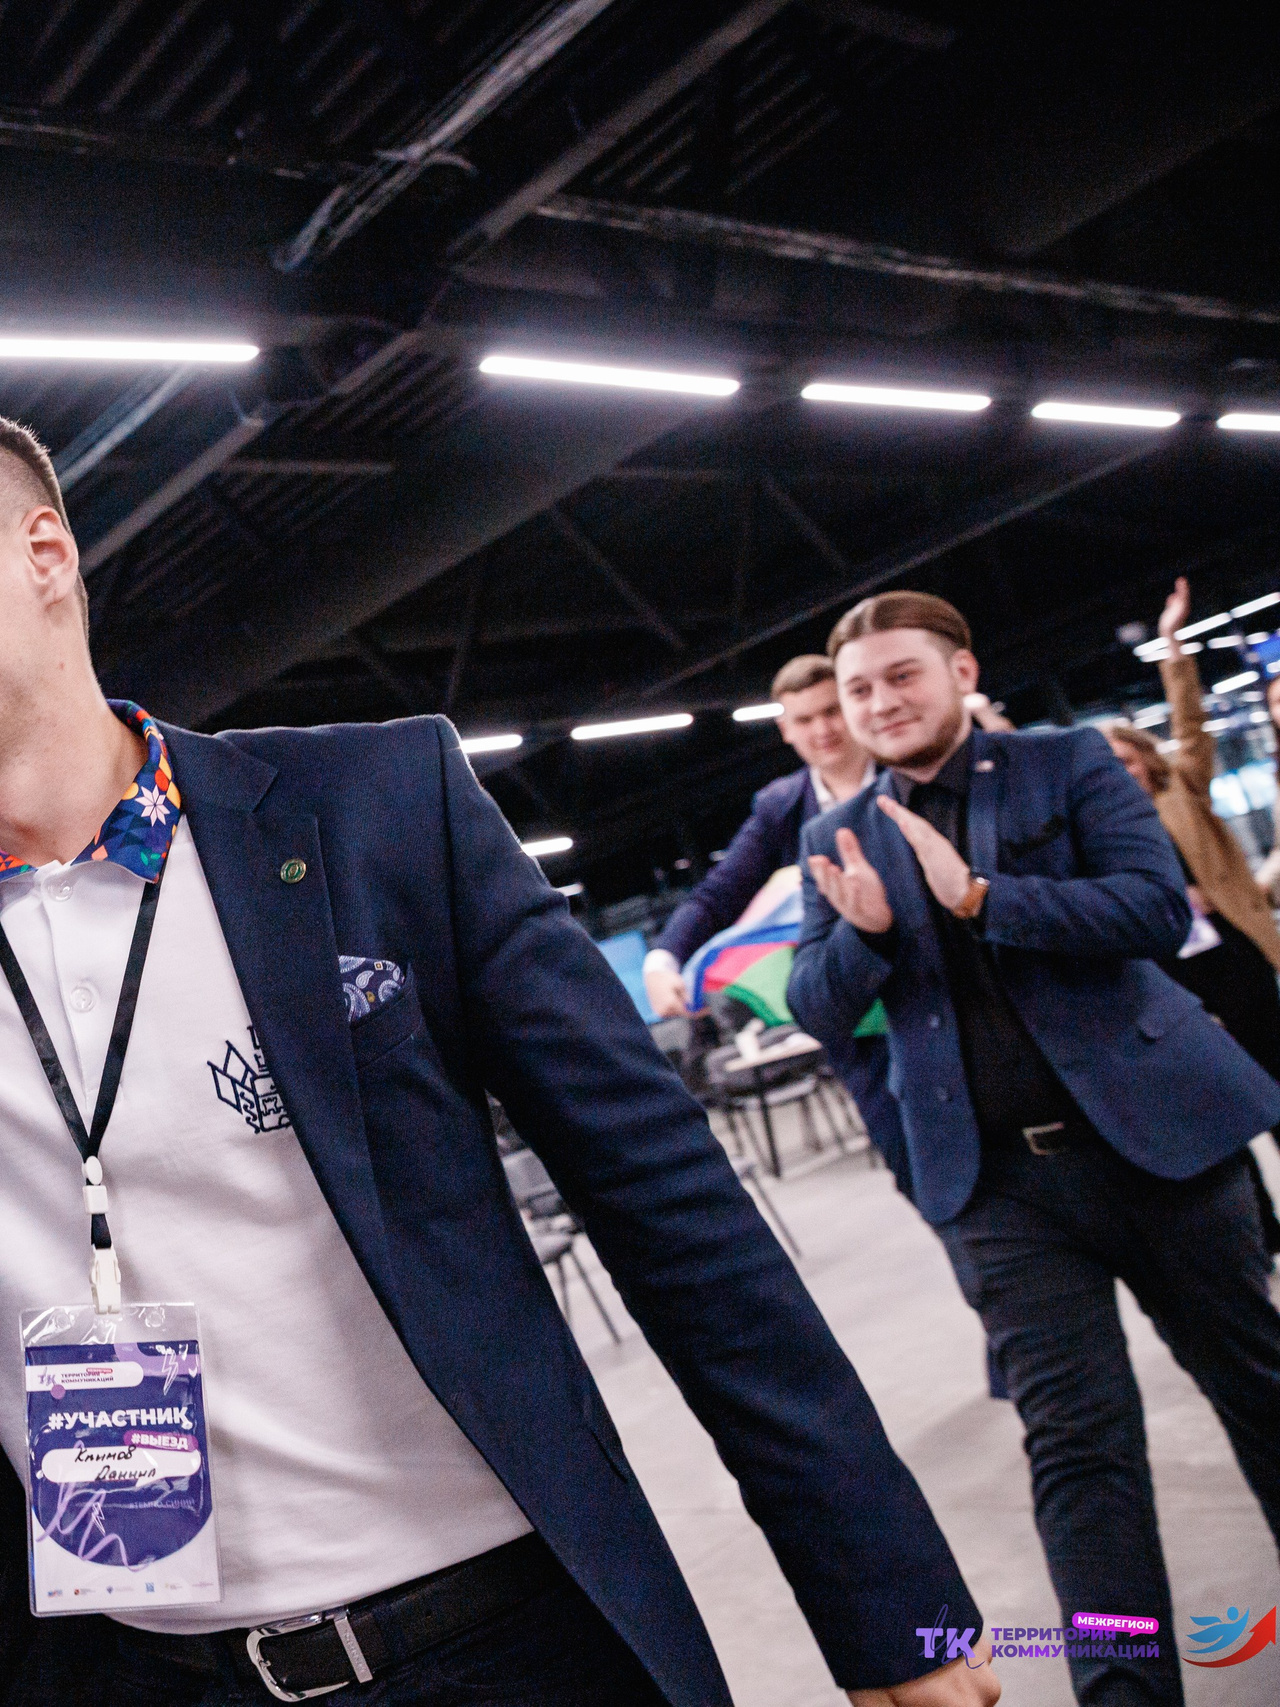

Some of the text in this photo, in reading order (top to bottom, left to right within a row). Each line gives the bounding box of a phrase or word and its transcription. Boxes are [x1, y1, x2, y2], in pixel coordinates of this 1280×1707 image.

[61, 1376, 114, 1384] КОММУНИКАЦИЙ
[48, 1406, 190, 1430] #УЧАСТНИК
[131, 1433, 189, 1450] #ВЫЕЗД
